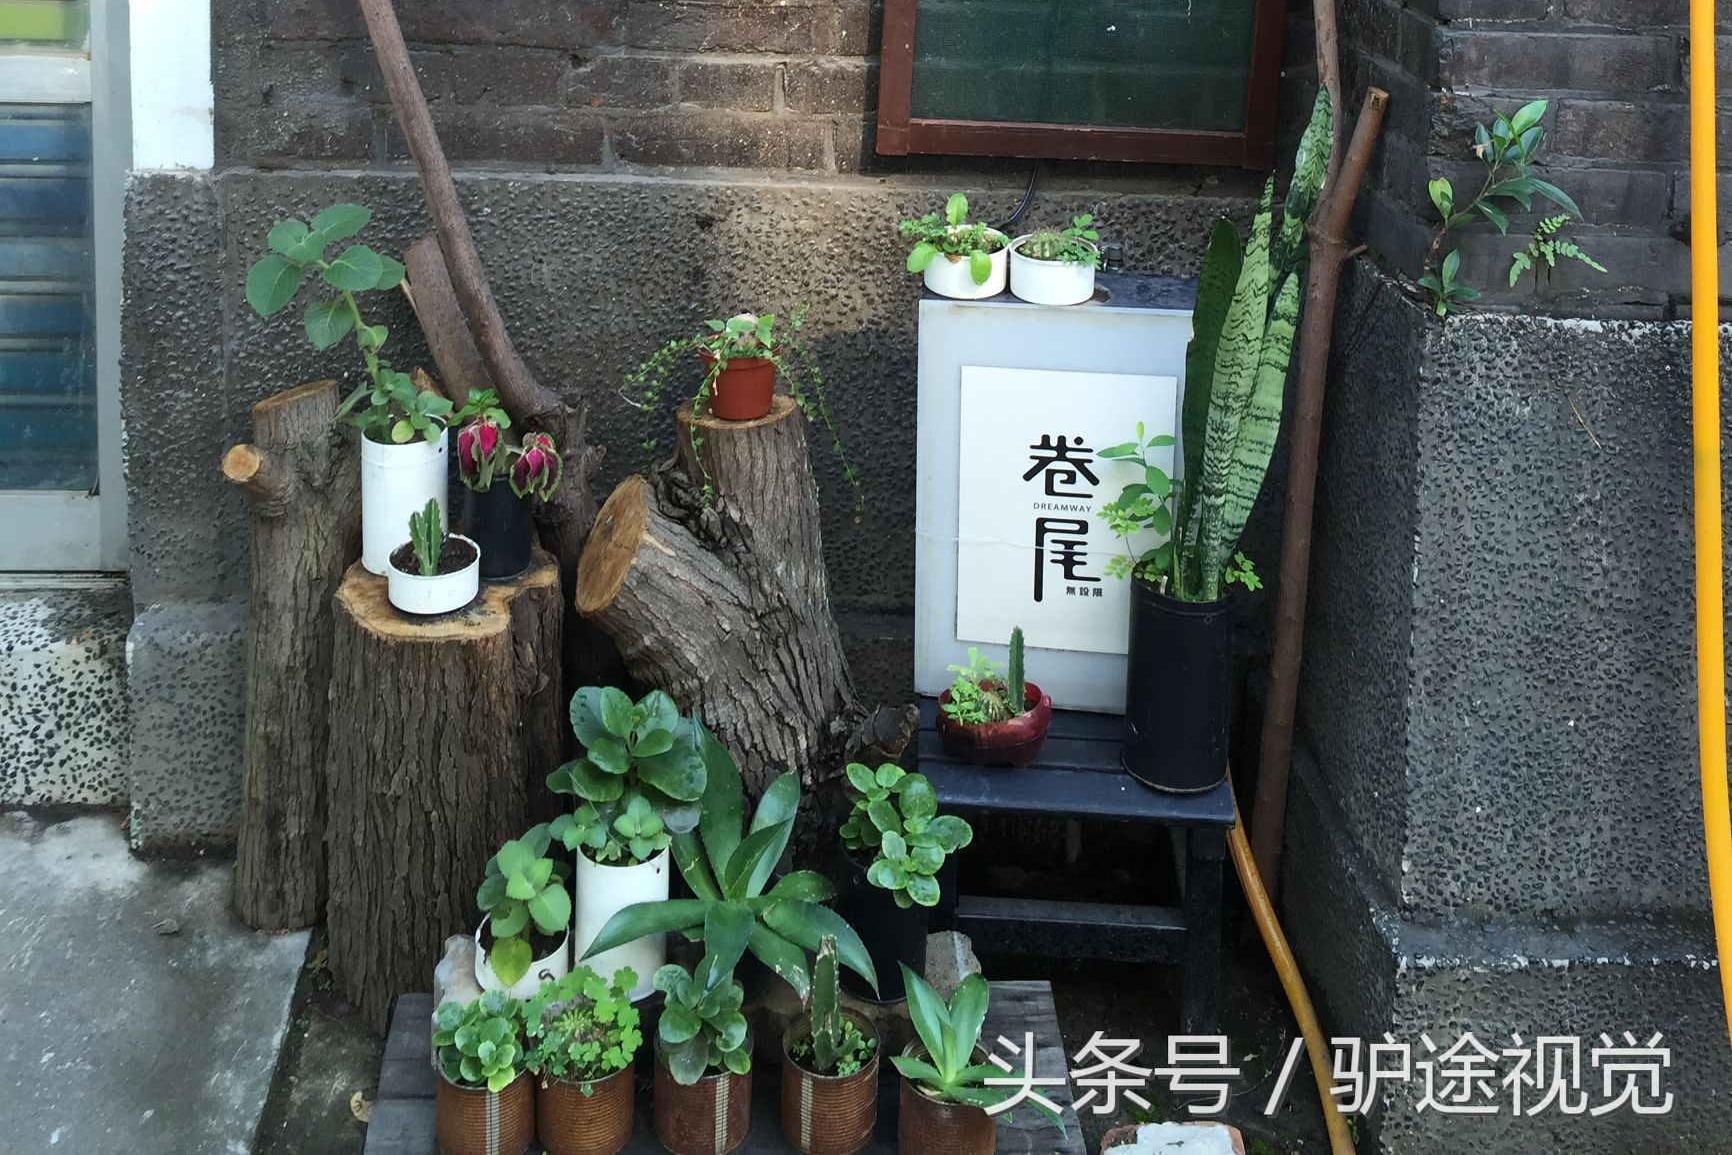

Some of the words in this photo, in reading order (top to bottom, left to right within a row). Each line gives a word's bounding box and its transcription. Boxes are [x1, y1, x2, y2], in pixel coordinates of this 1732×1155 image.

[1033, 502, 1092, 513] DREAMWAY
[1066, 585, 1103, 598] 無設限
